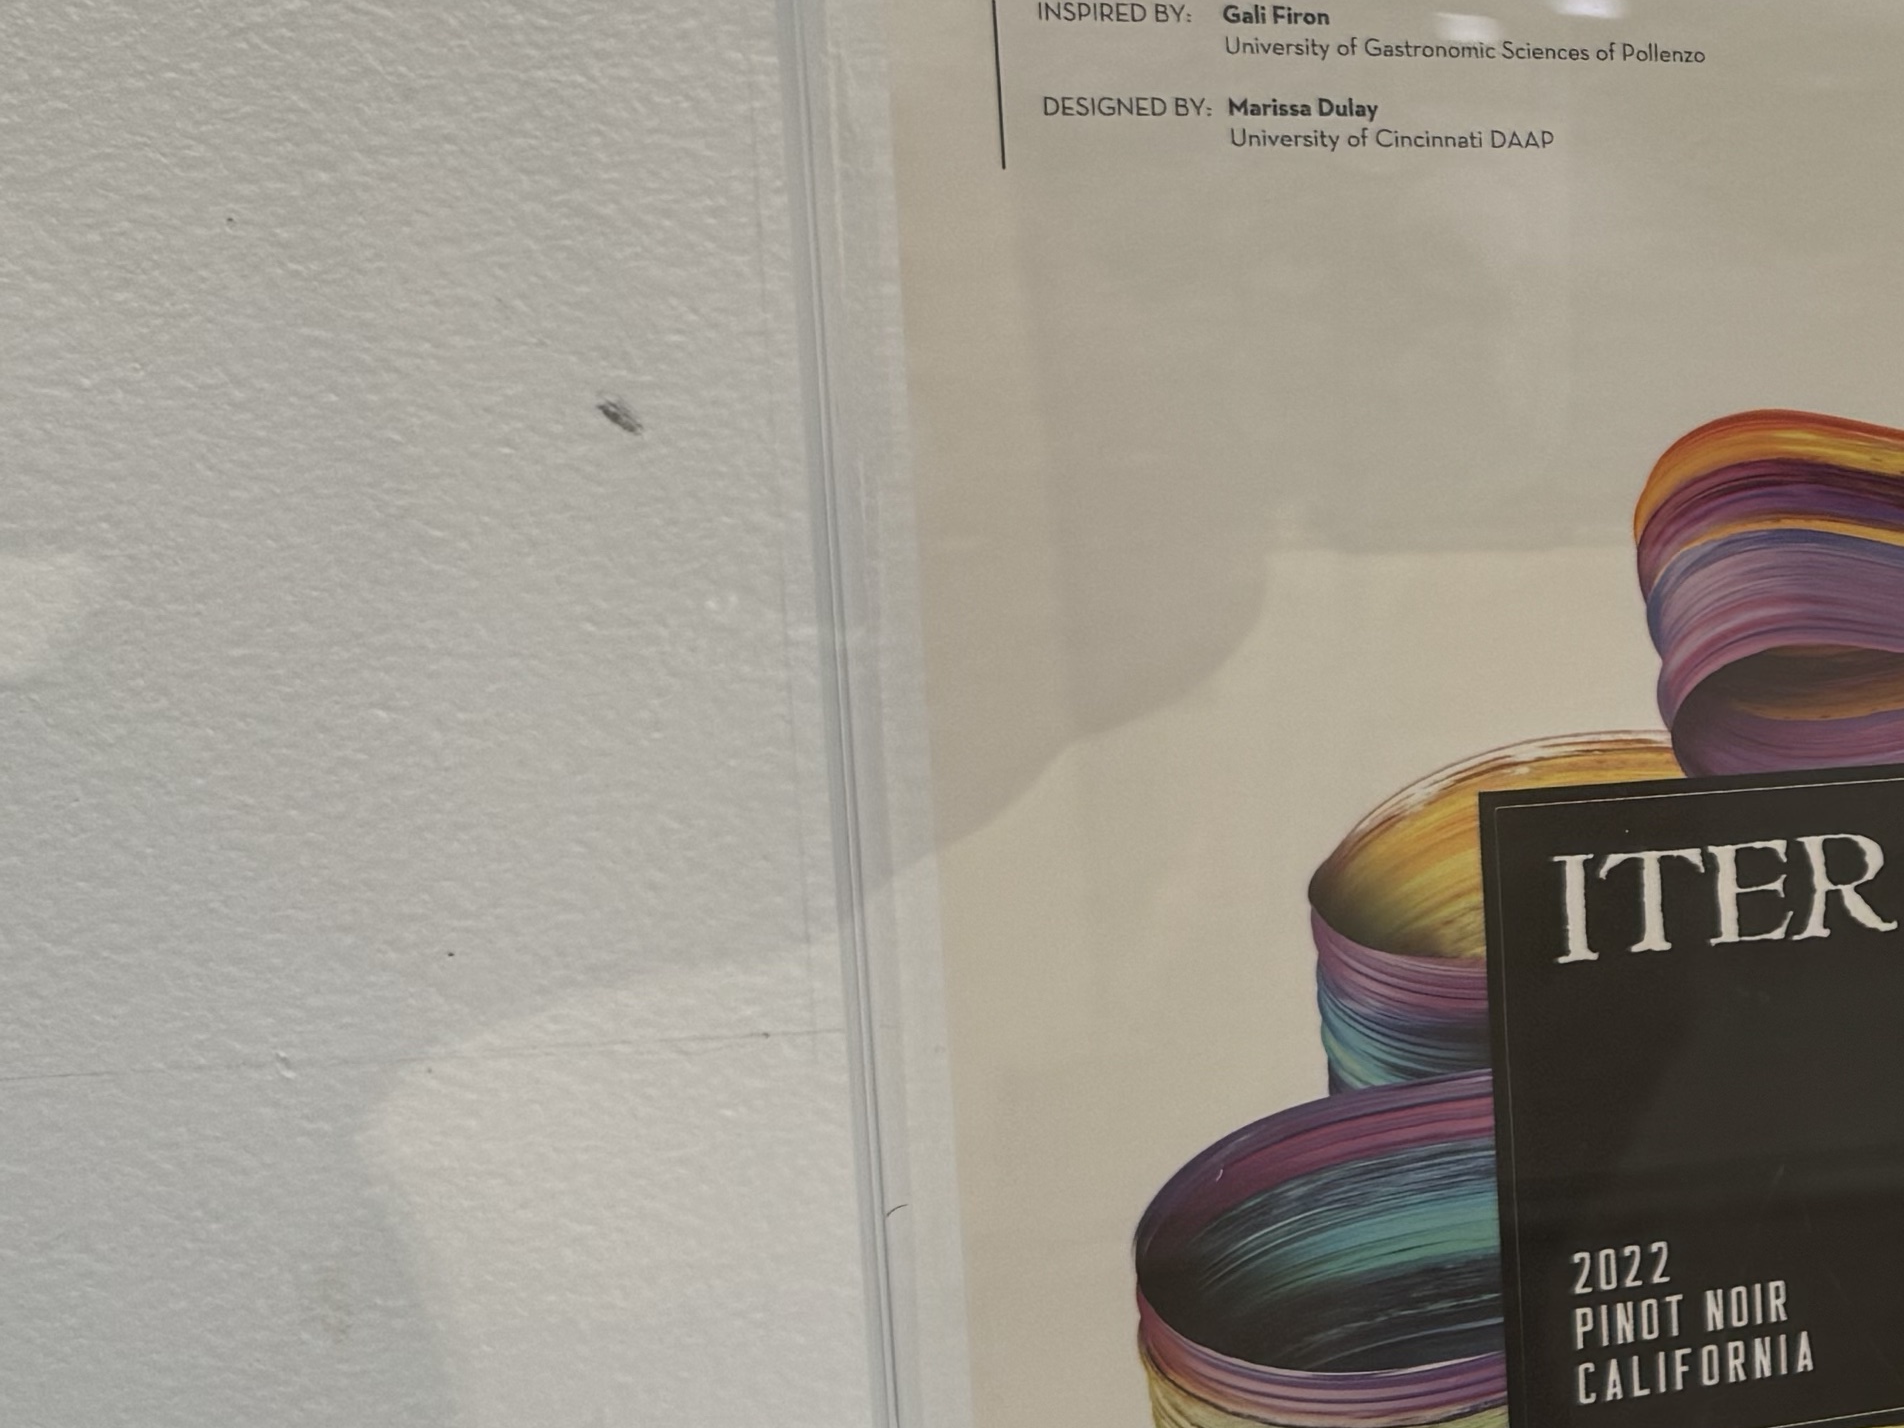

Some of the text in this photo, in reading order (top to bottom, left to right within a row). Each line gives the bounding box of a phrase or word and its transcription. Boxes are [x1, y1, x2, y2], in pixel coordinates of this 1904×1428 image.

[1037, 1, 1330, 25] INSPIRED BY: Gali Firon
[1224, 35, 1705, 63] University of Gastronomic Sciences of Pollenzo
[1042, 95, 1378, 122] DESIGNED BY: Marissa Dulay
[1230, 126, 1554, 152] University of Cincinnati DAAP
[1552, 833, 1898, 964] ITER
[1571, 1241, 1672, 1295] 2022
[1574, 1279, 1789, 1352] PINOT NOIR
[1577, 1331, 1815, 1406] CALIFORNIA
